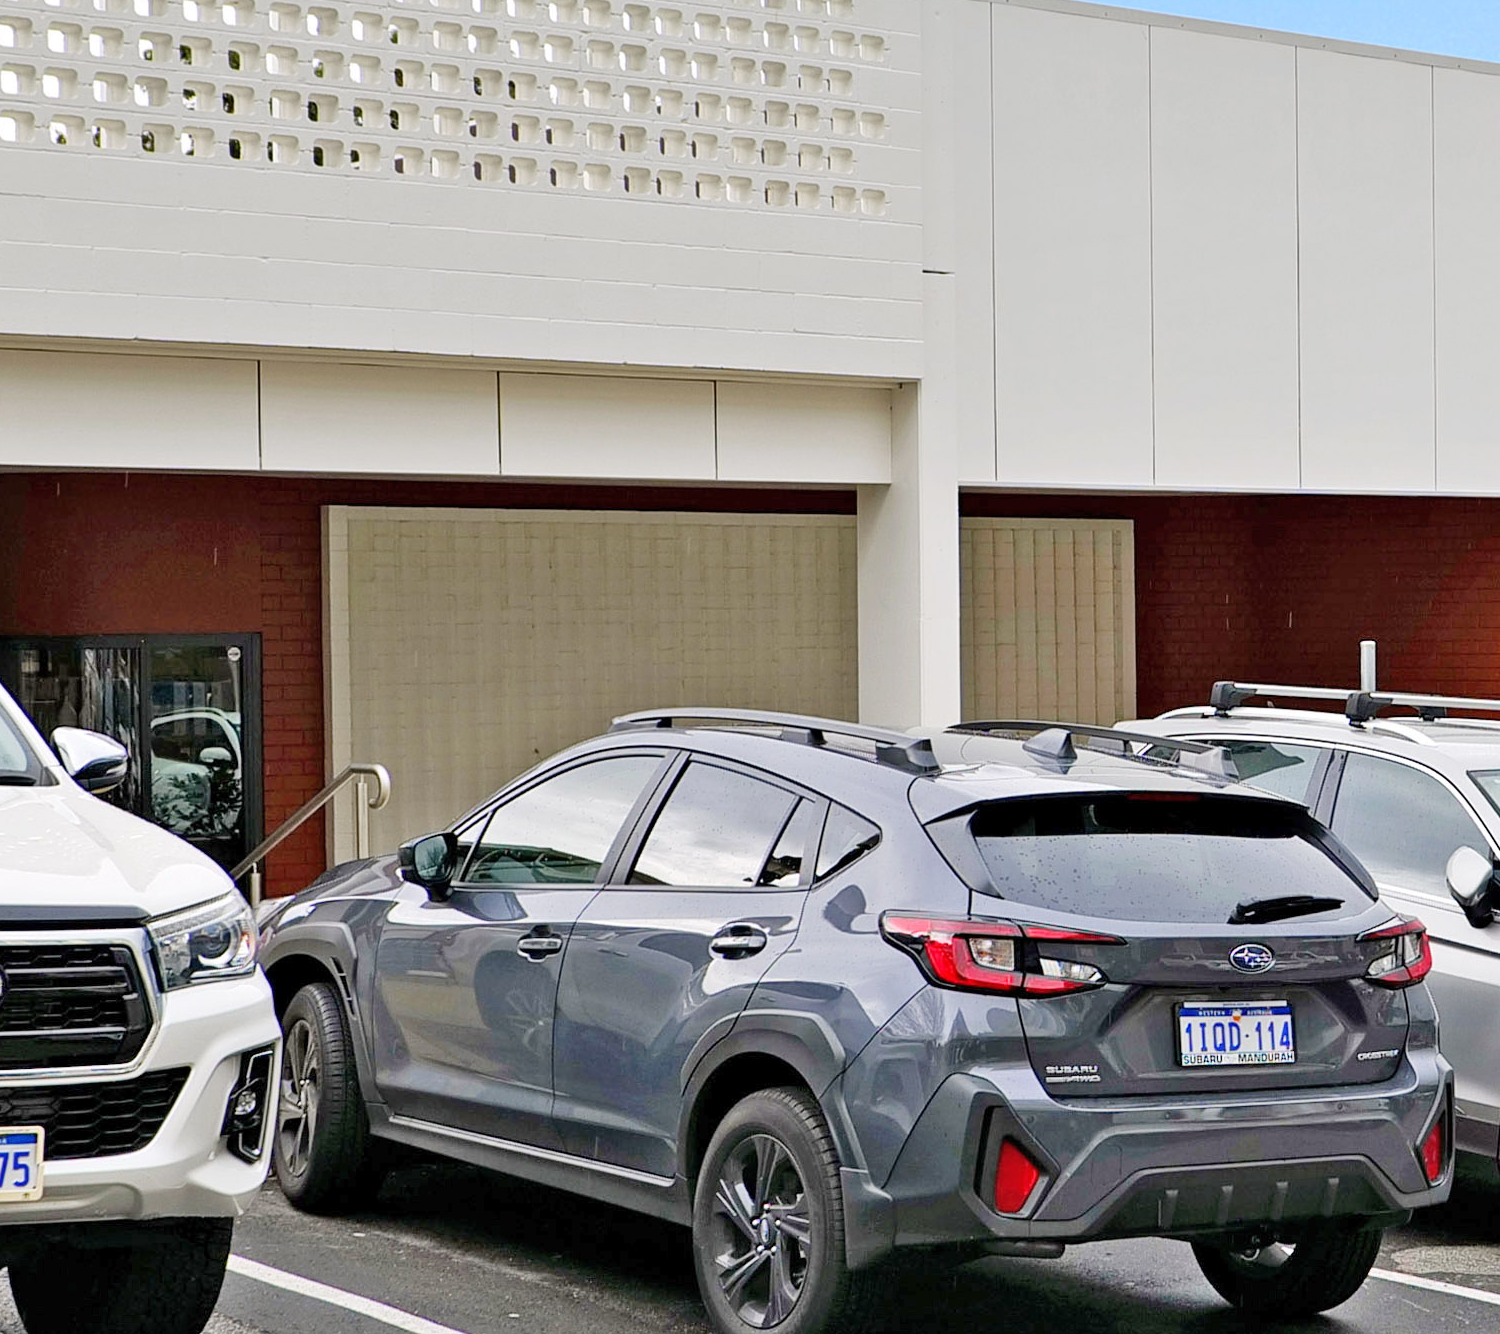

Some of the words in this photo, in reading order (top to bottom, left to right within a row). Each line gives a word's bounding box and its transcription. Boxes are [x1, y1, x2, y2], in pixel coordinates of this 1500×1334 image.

[1183, 1055, 1223, 1065] SUBARU
[1237, 1051, 1293, 1064] MANDURAH
[1045, 1065, 1098, 1074] SUBARU
